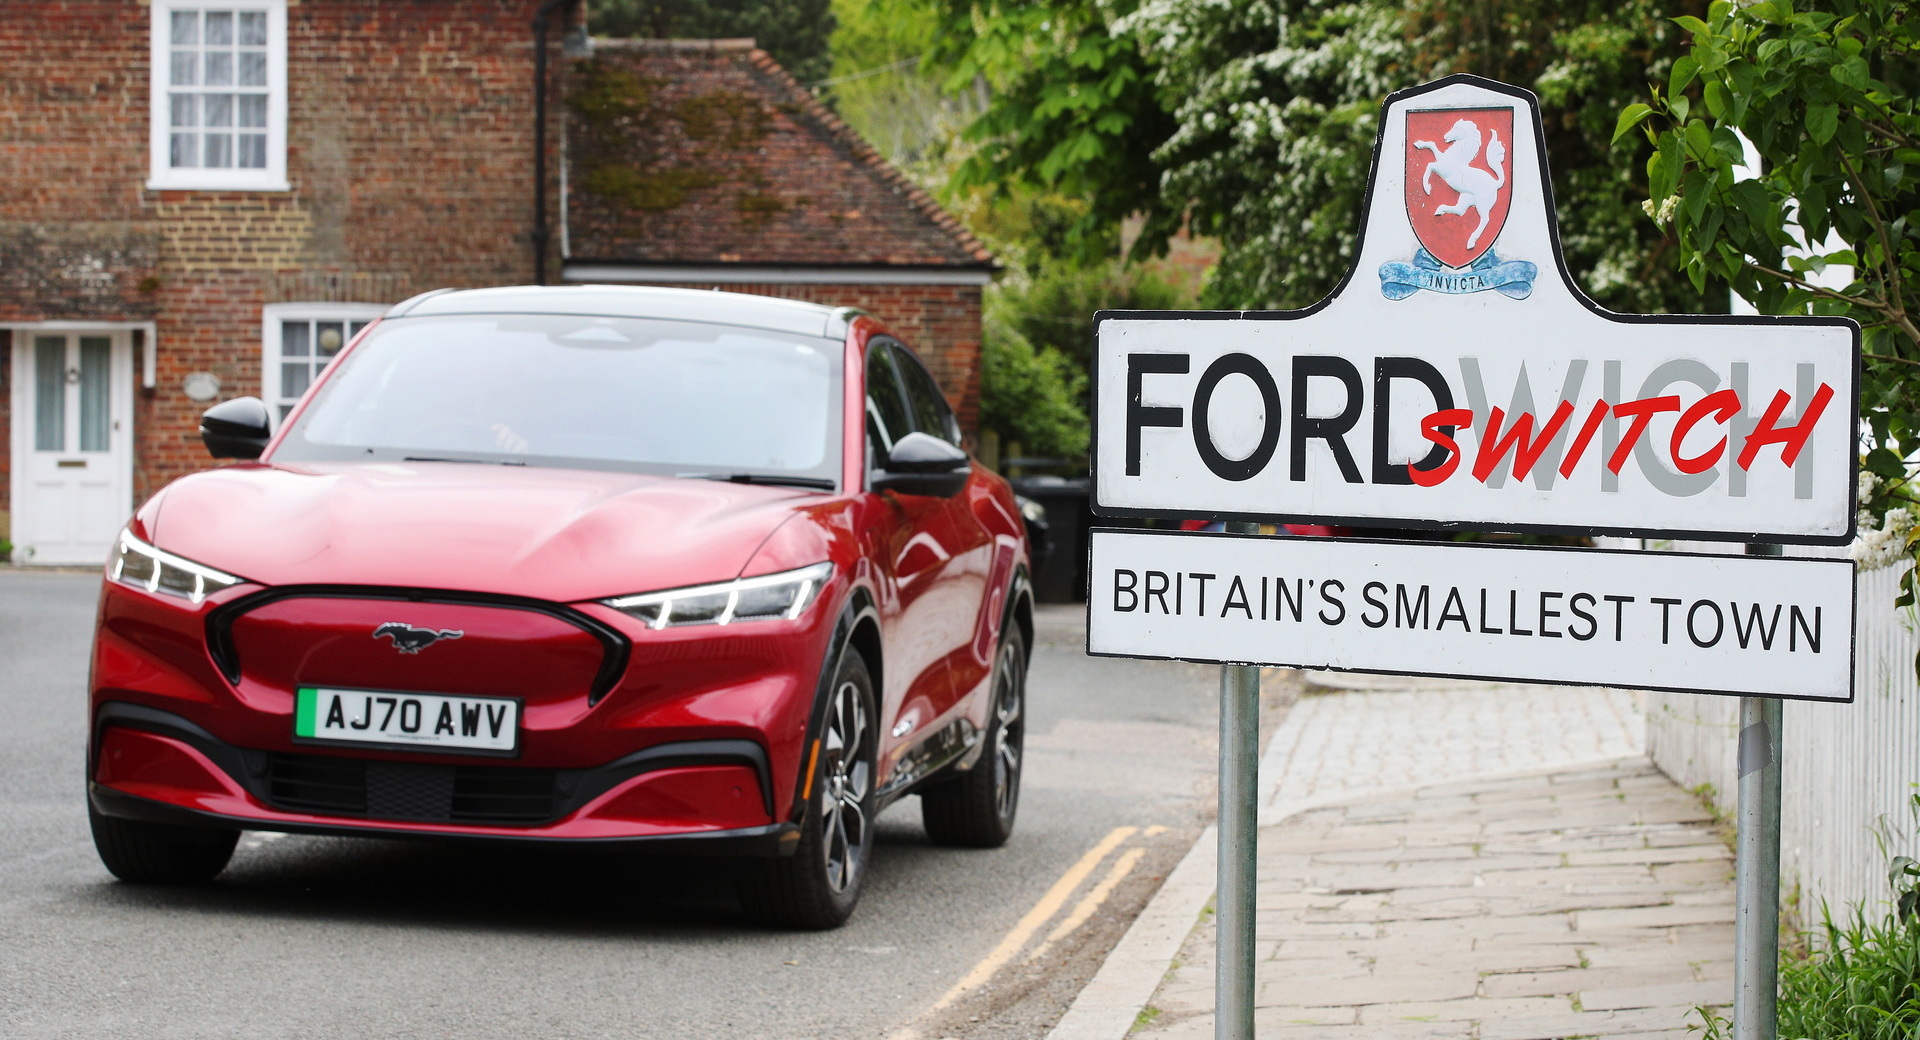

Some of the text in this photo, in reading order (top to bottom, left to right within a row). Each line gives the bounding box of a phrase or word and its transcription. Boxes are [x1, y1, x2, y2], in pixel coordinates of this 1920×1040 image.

[1429, 274, 1485, 291] INVICTA
[1407, 382, 1835, 488] SWITCH
[1113, 568, 1822, 654] BRITAIN'S SMALLEST TOWN
[325, 694, 506, 738] AJ70 AWV
